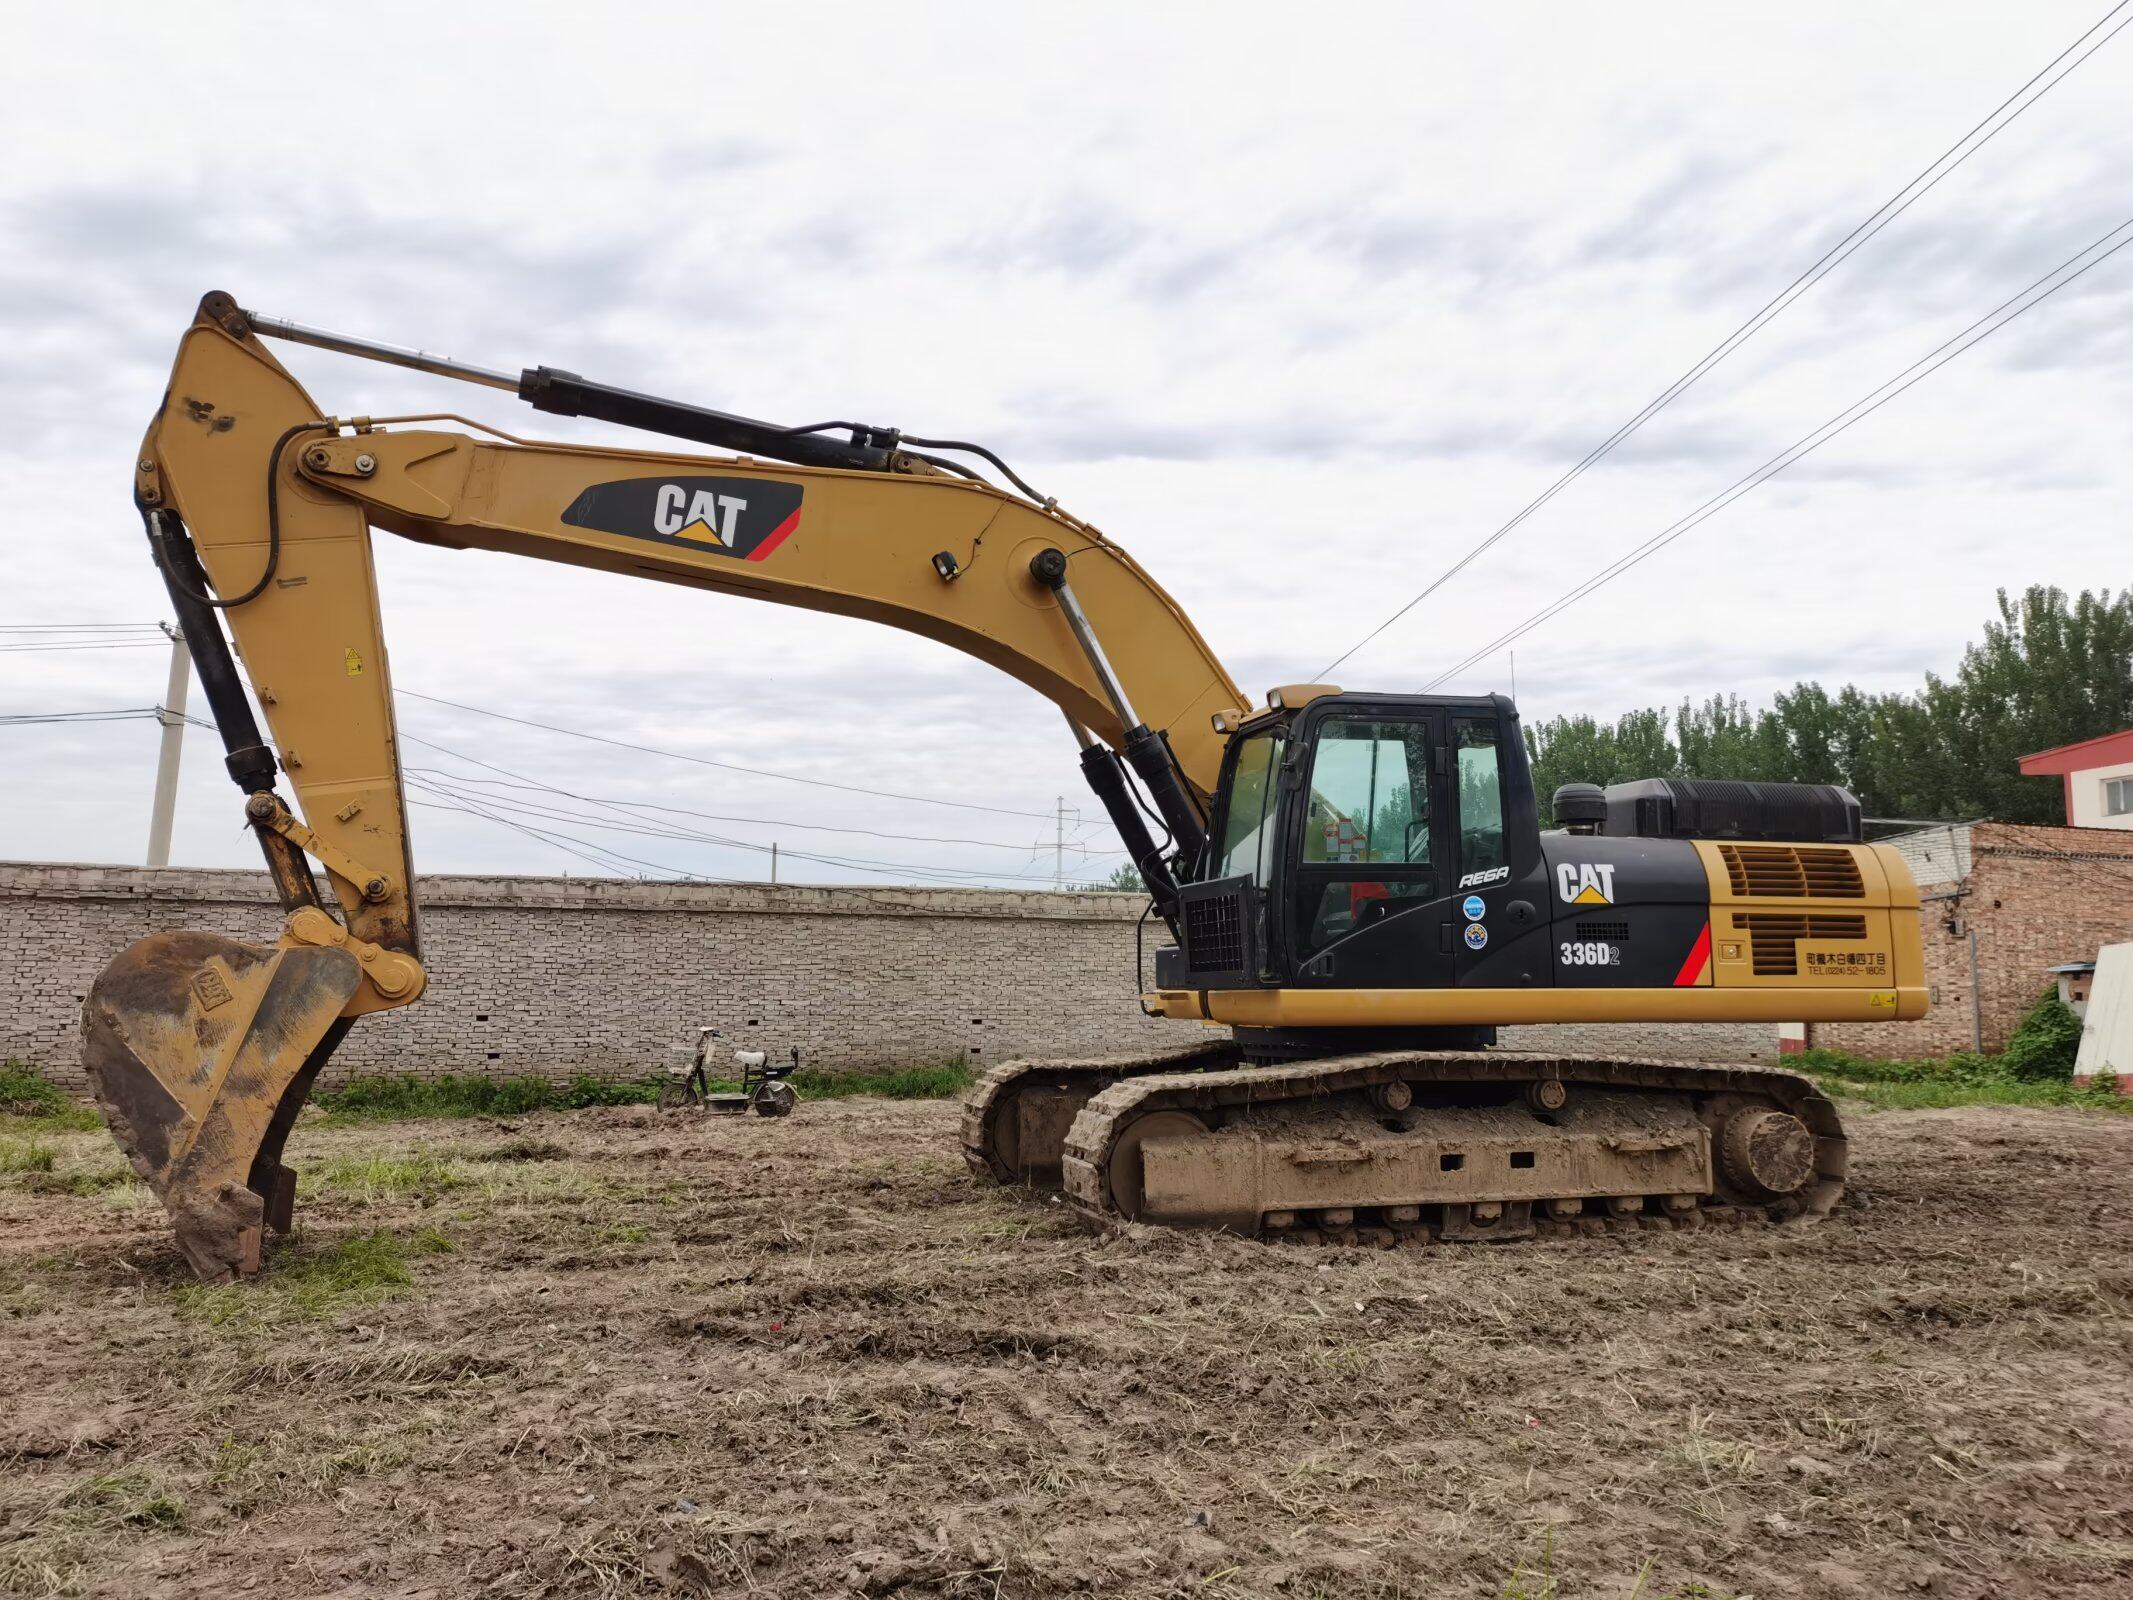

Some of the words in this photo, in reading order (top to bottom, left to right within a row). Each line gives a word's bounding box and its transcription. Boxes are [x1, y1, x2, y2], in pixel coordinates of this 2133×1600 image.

[654, 484, 747, 548] CAT
[1458, 866, 1510, 889] REGA
[1556, 863, 1615, 904] CAT
[1560, 942, 1620, 966] 336D2
